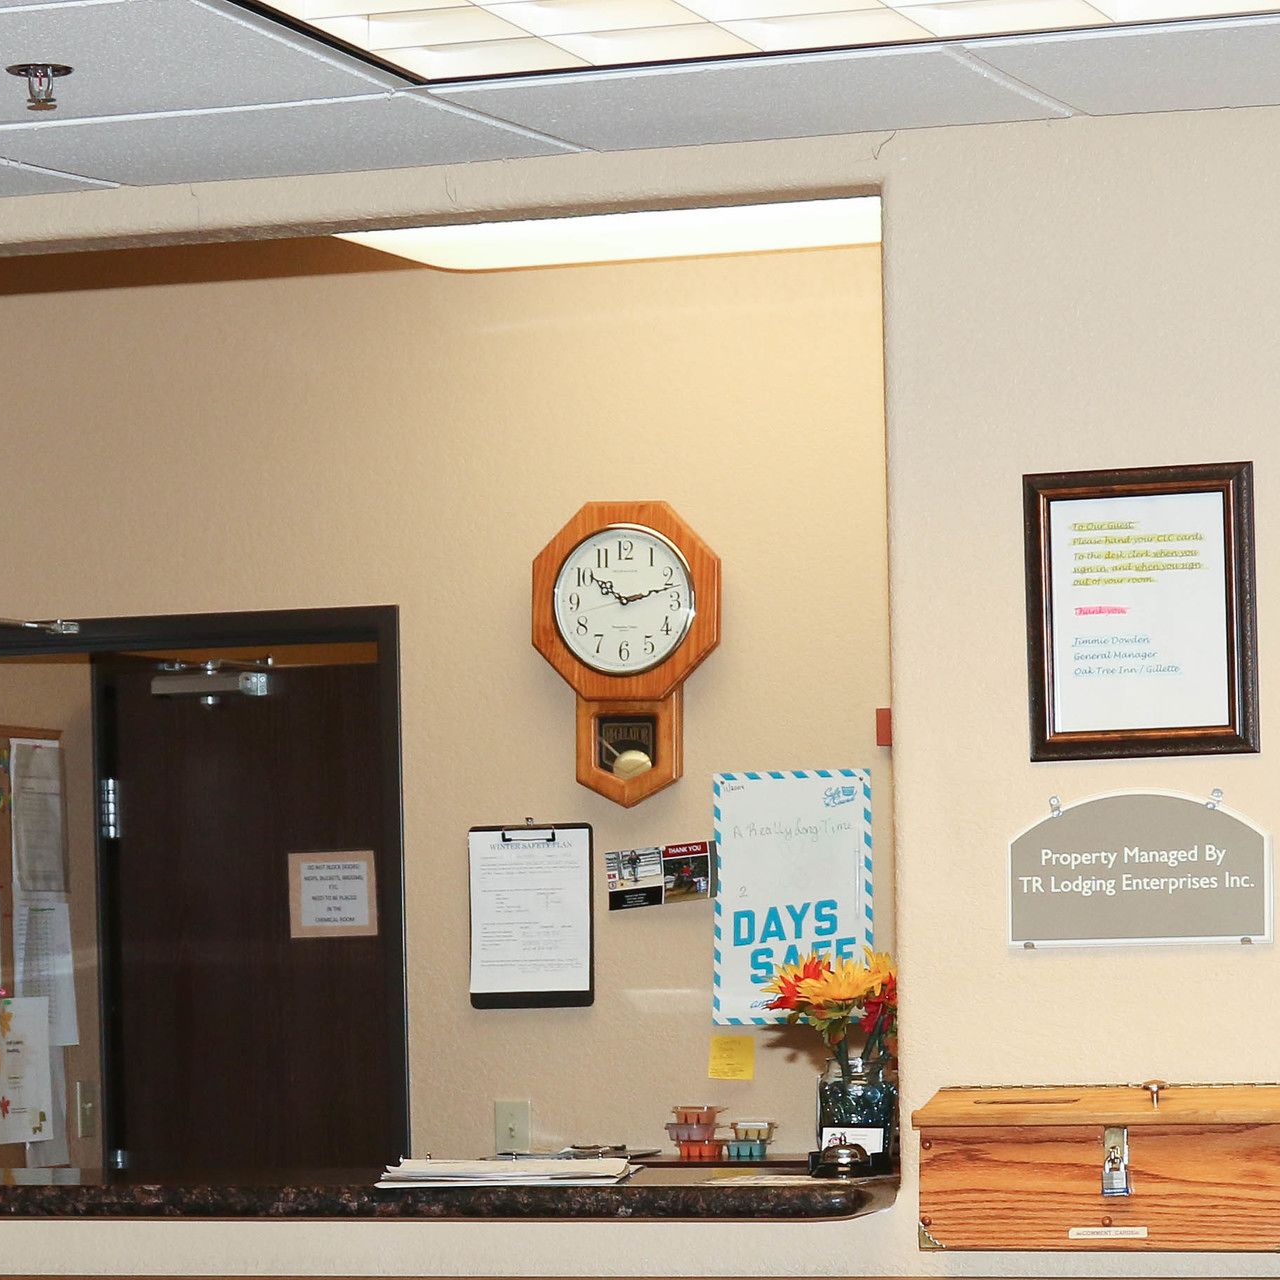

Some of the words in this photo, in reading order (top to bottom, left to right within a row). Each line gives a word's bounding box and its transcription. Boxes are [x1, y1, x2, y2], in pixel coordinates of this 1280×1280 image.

[1073, 523, 1083, 531] To
[1072, 537, 1100, 545] Please
[1104, 535, 1130, 545] hand
[1133, 536, 1153, 545] your
[1176, 532, 1203, 541] cards
[596, 548, 609, 568] 11
[617, 540, 634, 561] 12
[649, 547, 654, 567] 1
[1087, 551, 1101, 560] the
[1104, 550, 1125, 559] desk
[1153, 549, 1178, 558] when
[1180, 550, 1197, 558] you
[576, 567, 593, 587] 10
[662, 566, 674, 586] 2
[1135, 562, 1159, 572] when
[1161, 563, 1178, 571] you
[1073, 578, 1090, 586] out
[569, 593, 580, 611] 9
[670, 591, 681, 611] 3
[576, 616, 588, 636] 8
[660, 615, 672, 636] 4
[593, 634, 604, 654] 7
[618, 641, 630, 662] 6
[643, 635, 655, 655] 5
[1073, 651, 1111, 661] General
[1113, 651, 1158, 661] Manager
[1073, 666, 1094, 676] Oak
[1097, 666, 1117, 675] Tree
[1119, 665, 1137, 674] Inn
[1146, 664, 1180, 673] Gillette
[733, 825, 743, 839] A
[748, 822, 792, 841] Really
[490, 843, 521, 851] WINTER
[668, 846, 688, 854] THANK
[689, 844, 702, 852] YOU
[1041, 849, 1118, 869] Property
[1123, 846, 1198, 867] Managed
[1205, 844, 1227, 866] By
[1019, 876, 1045, 893] TR
[1051, 875, 1116, 896] Lodging
[1122, 873, 1218, 894] Enterprises
[1225, 871, 1255, 888] Inc.
[733, 898, 838, 947] DAYS
